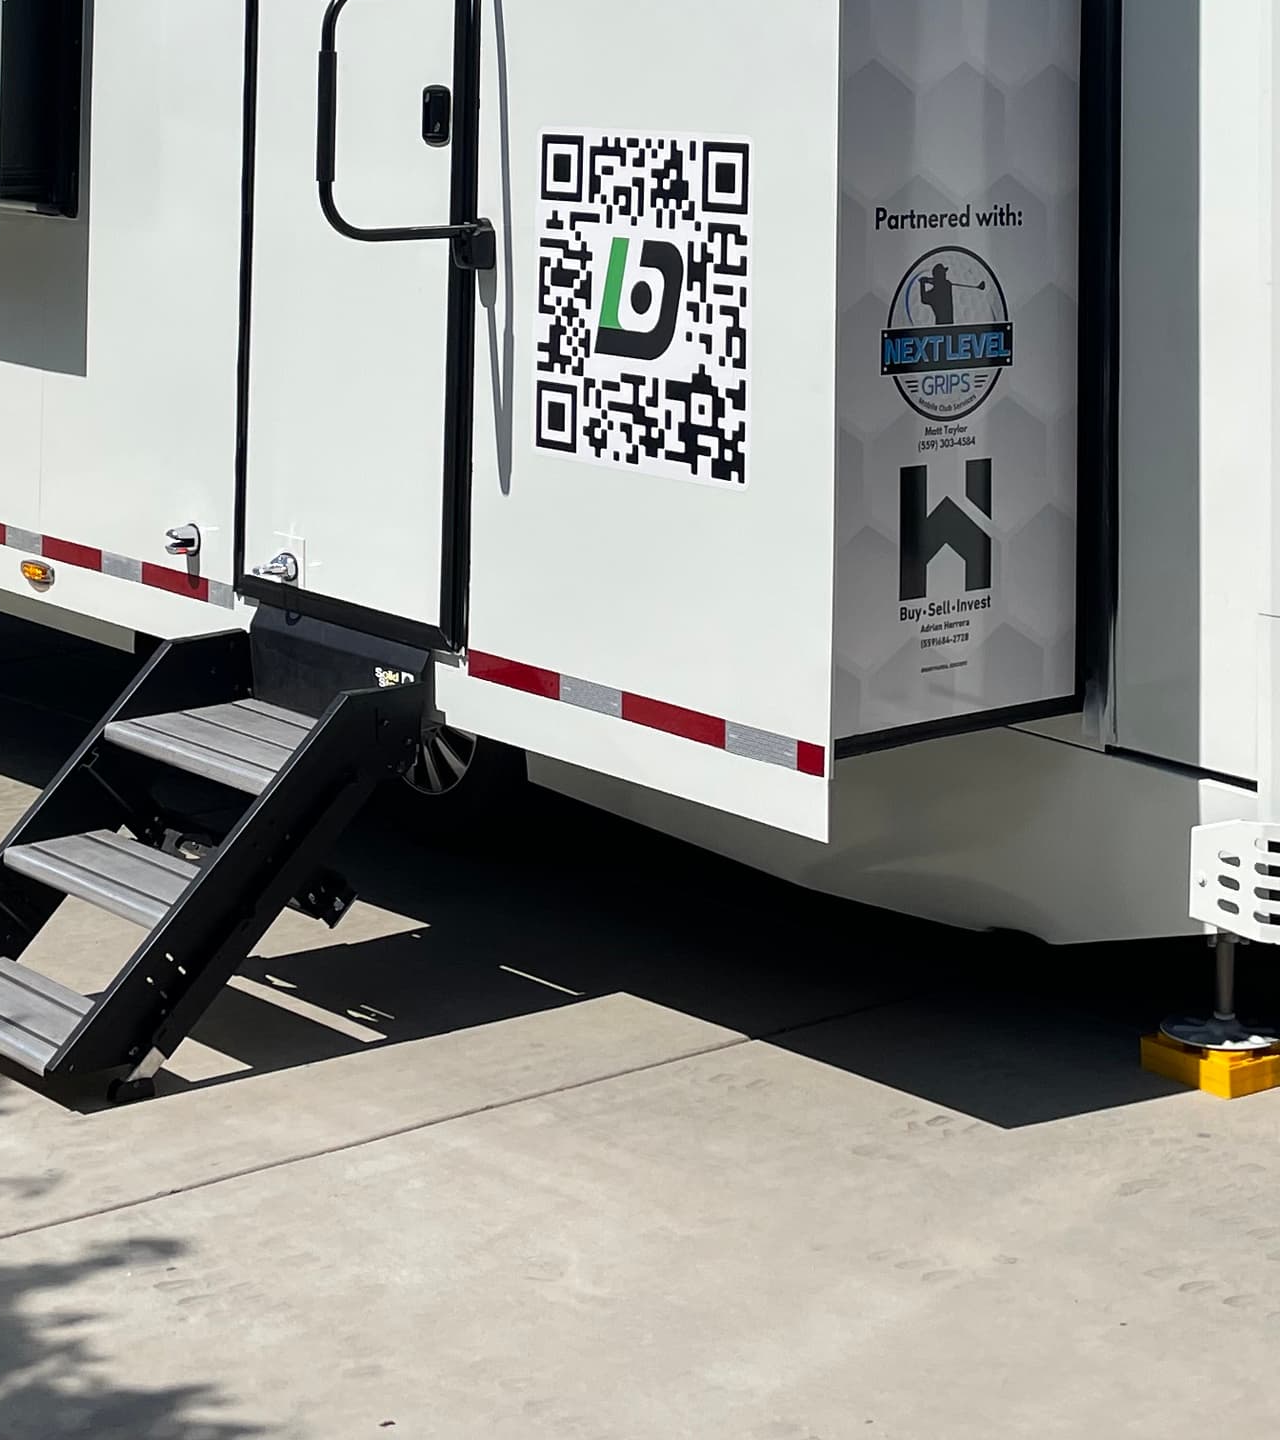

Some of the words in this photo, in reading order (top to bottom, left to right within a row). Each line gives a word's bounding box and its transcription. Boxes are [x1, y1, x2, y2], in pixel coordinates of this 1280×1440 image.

[875, 204, 971, 231] Partnered
[975, 203, 1023, 227] with:
[921, 372, 971, 396] GRIPS
[943, 424, 968, 436] Taylor
[917, 439, 938, 452] (559)
[375, 667, 399, 682] Solid
